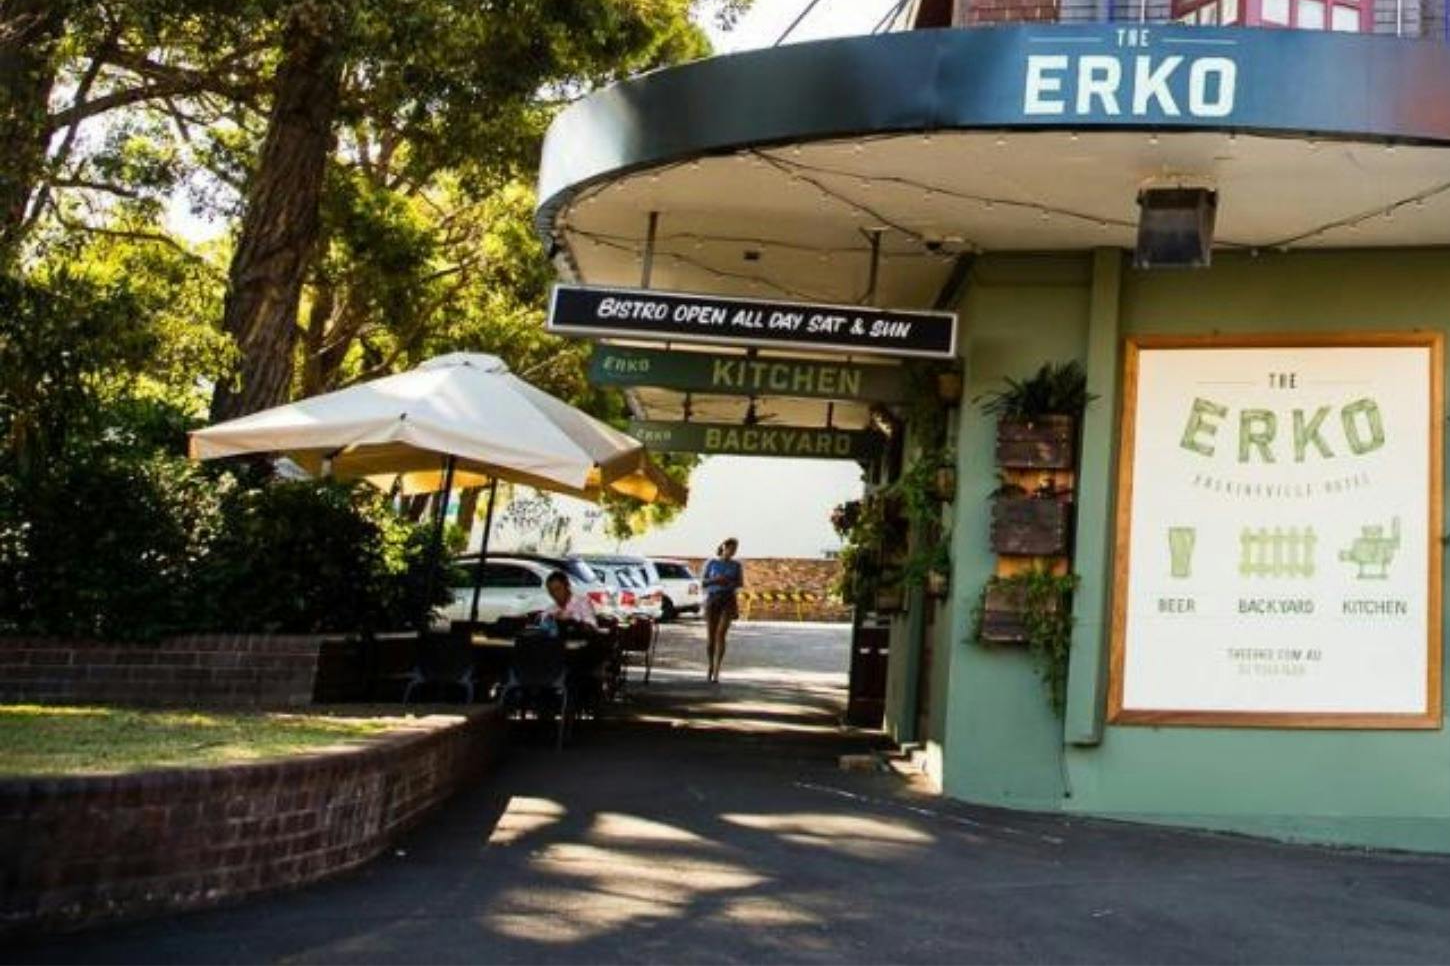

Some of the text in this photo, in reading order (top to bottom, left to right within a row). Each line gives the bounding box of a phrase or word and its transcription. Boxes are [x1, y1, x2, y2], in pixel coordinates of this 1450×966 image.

[1116, 28, 1150, 47] THE
[1023, 54, 1238, 118] ERKO
[673, 303, 728, 325] OPEN
[731, 309, 764, 328] ALL
[769, 311, 803, 330] DAY
[806, 314, 848, 334] SAT
[850, 317, 866, 335] &
[869, 319, 912, 339] SUN
[712, 358, 863, 396] KITCHEN
[1268, 372, 1298, 389] THE
[705, 428, 852, 455] BACKYARD
[1180, 396, 1386, 464] ERKO
[1157, 597, 1408, 616] BEER BACKYARD KITCHEN
